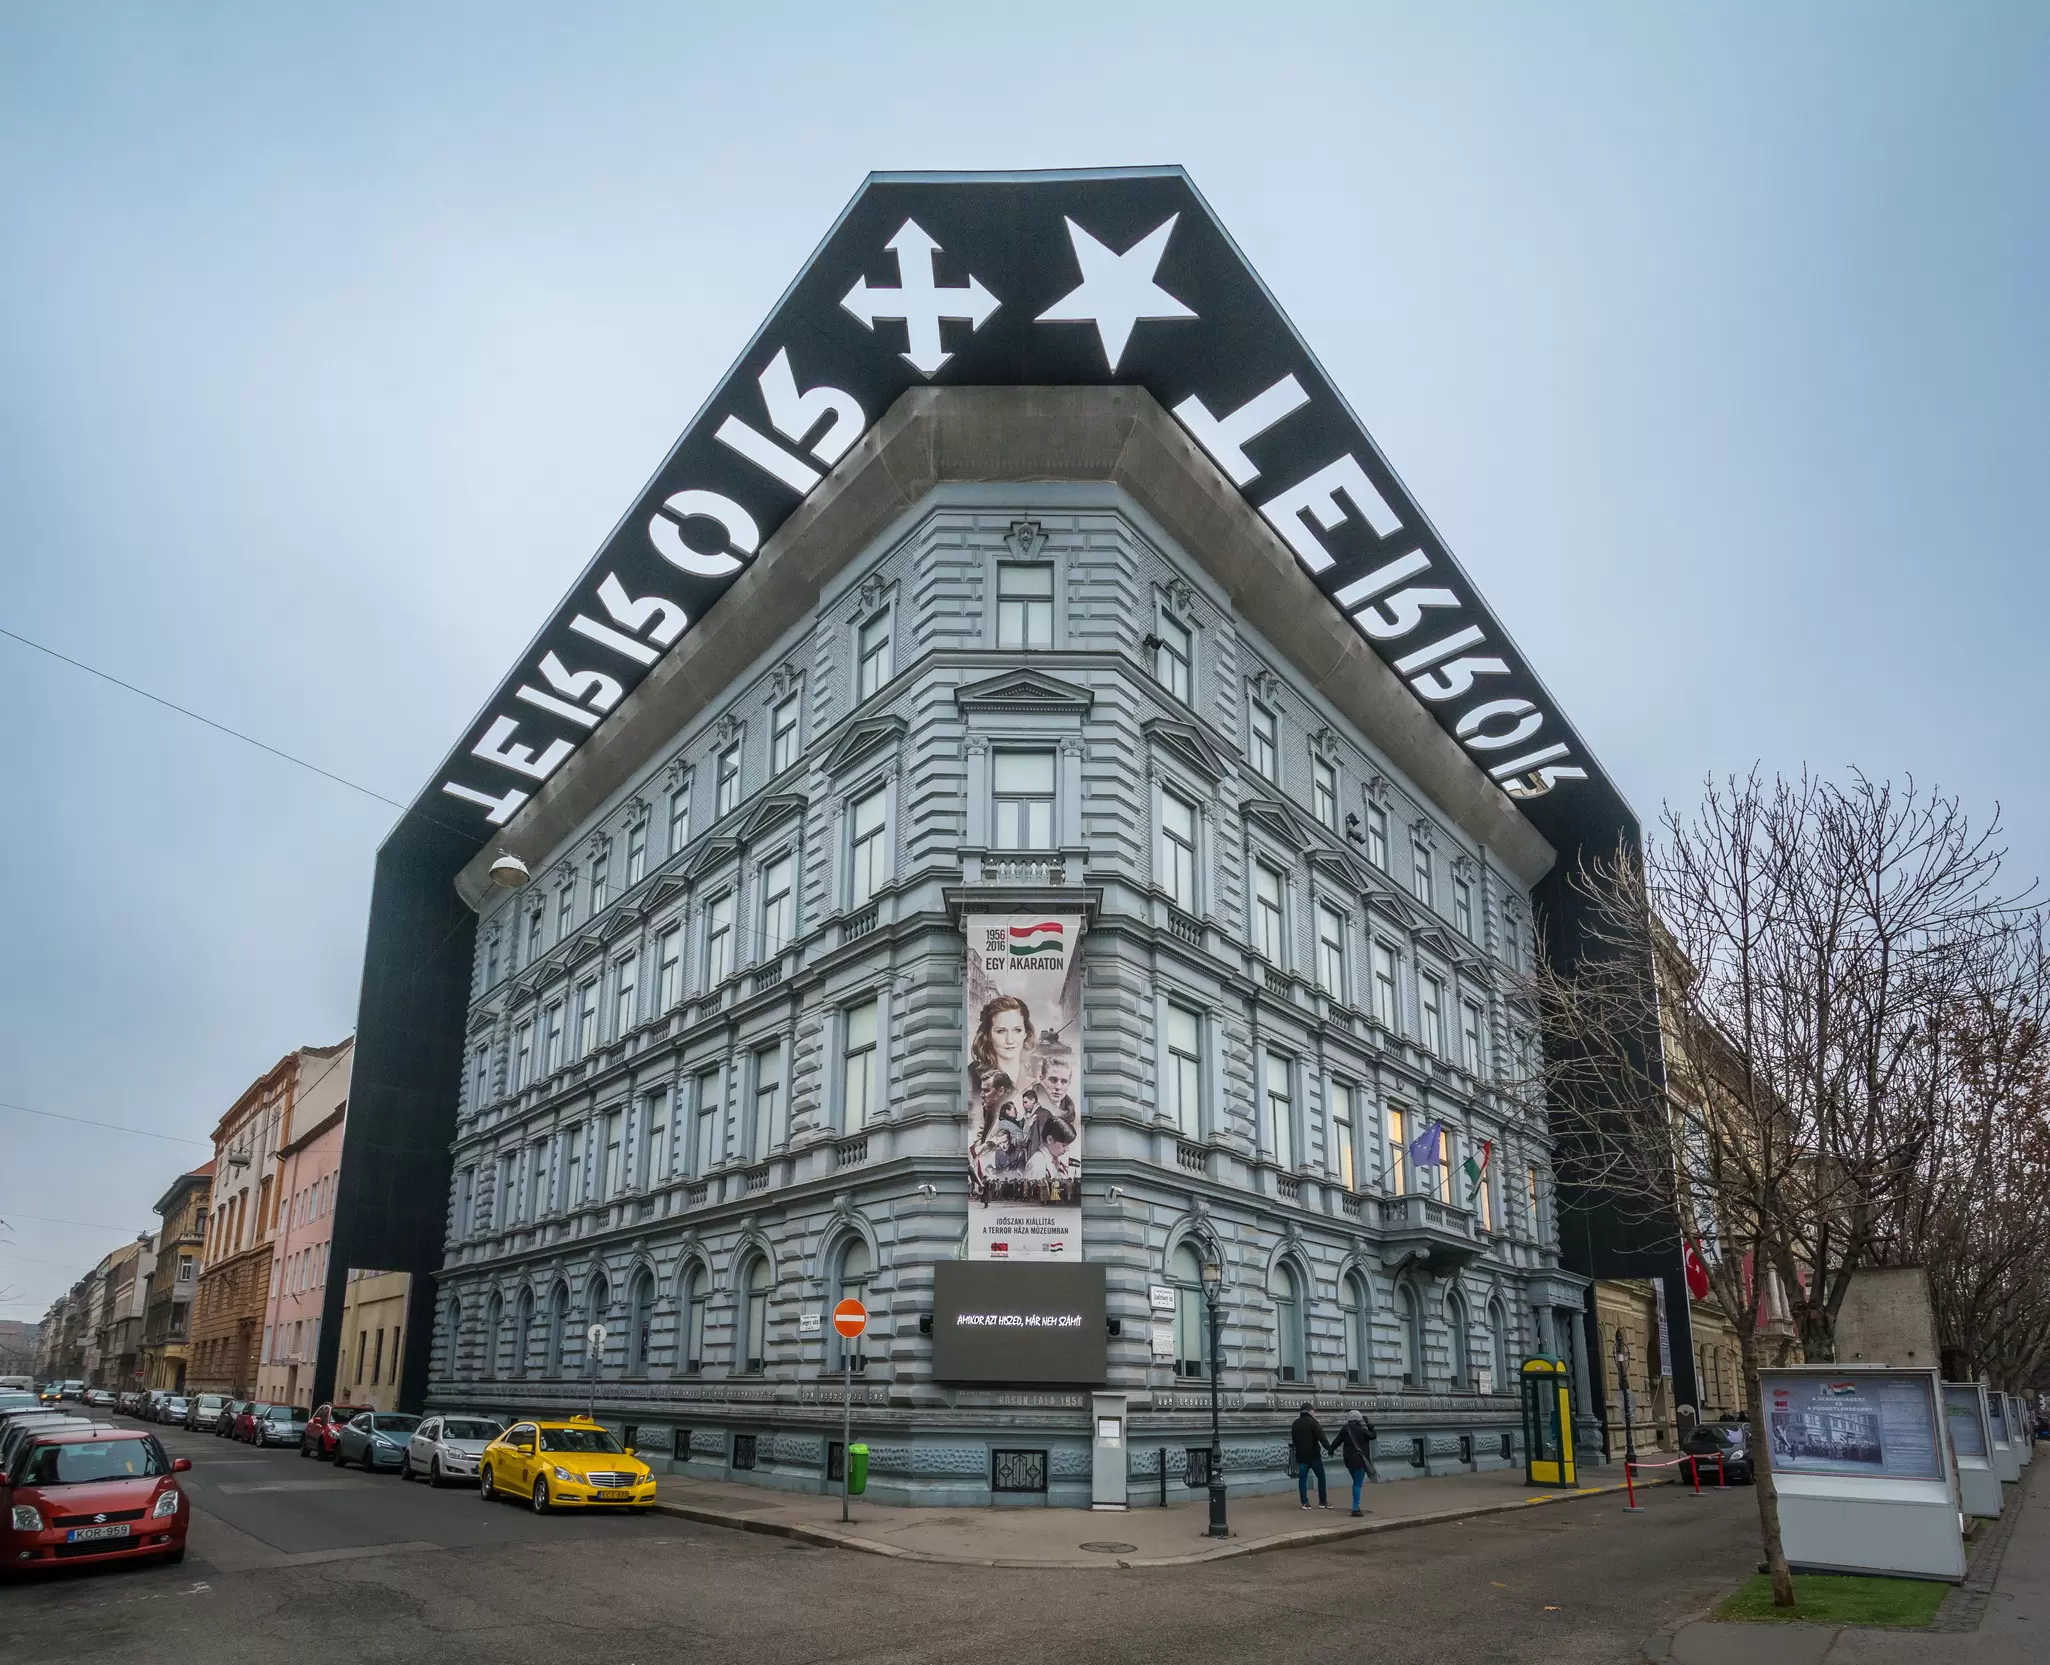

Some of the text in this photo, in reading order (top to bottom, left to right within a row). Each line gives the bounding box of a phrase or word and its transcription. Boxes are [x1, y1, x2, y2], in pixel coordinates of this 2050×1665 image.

[986, 929, 1006, 941] 1956
[986, 941, 1006, 952] 2016
[986, 957, 1064, 970] EGY AKARATON
[996, 1216, 1056, 1226] IDŐSZAKI KIÁLLÍTÁS
[989, 1226, 1012, 1234] TERROR
[1013, 1225, 1029, 1235] HÁZA
[1030, 1226, 1069, 1235] MÚZEUMBAN
[957, 1313, 985, 1326] AMIKOR
[985, 1315, 998, 1326] AZT
[998, 1315, 1024, 1328] HISZED,
[1025, 1314, 1041, 1327] MÁR
[1041, 1316, 1058, 1327] NEM
[1060, 1396, 1083, 1407] 1956
[76, 1525, 128, 1539] KOR-959
